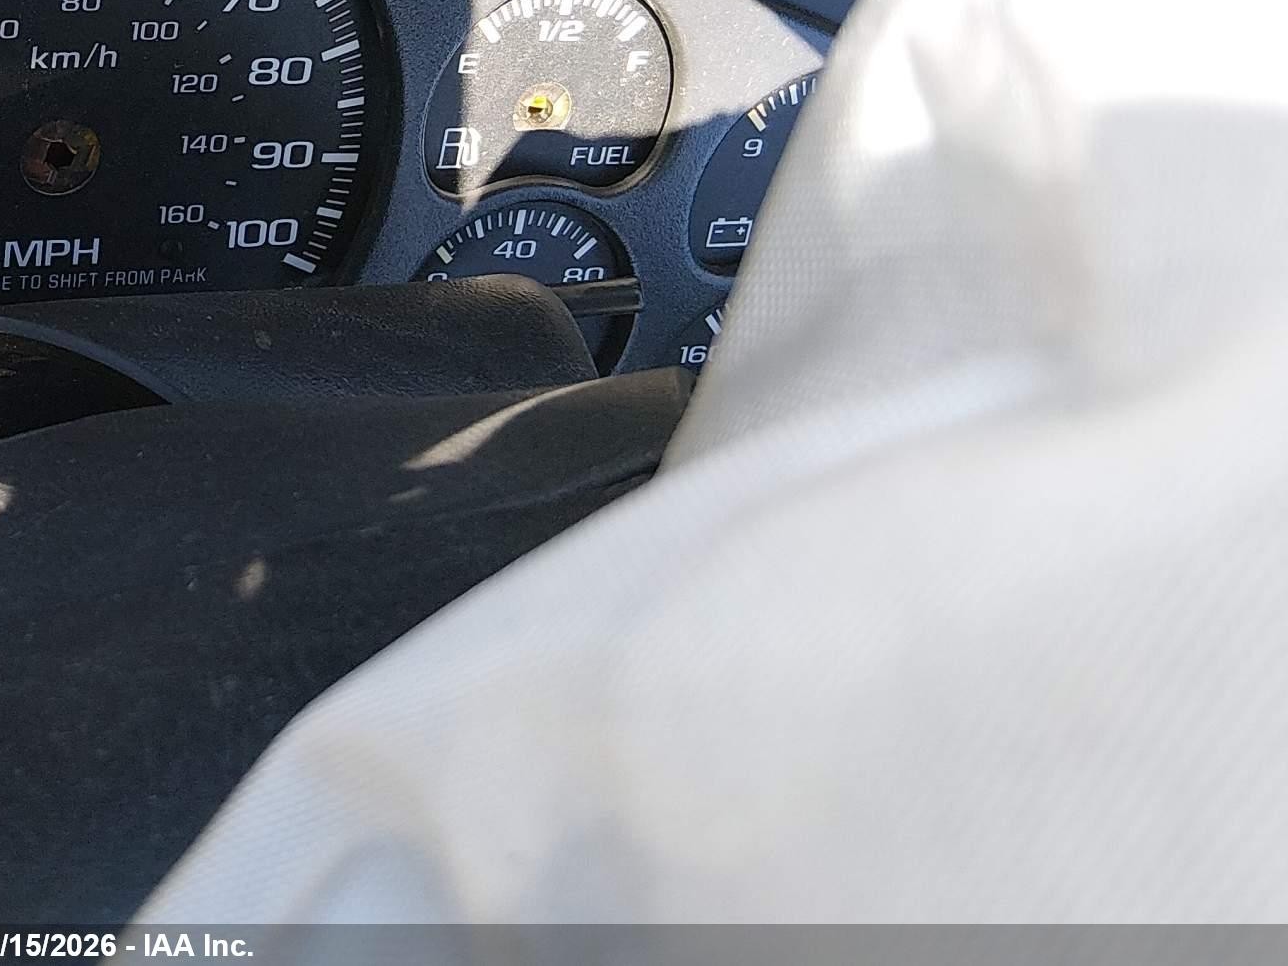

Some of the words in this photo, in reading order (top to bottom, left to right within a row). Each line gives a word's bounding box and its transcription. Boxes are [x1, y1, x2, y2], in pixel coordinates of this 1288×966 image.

[131, 21, 179, 41] 100
[537, 19, 586, 43] 1/2
[30, 44, 118, 70] km/h
[458, 52, 480, 75] E
[626, 51, 652, 71] F
[248, 57, 312, 86] 80
[171, 73, 218, 94] 120
[181, 134, 228, 154] 140
[742, 138, 764, 158] 9
[251, 141, 314, 170] 90
[570, 146, 636, 167] FUEL
[159, 205, 205, 225] 160
[226, 219, 299, 250] 100
[3, 238, 101, 268] MPH
[493, 240, 537, 259] 40
[20, 274, 42, 291] TO
[48, 272, 98, 289] SHIFT
[105, 270, 154, 286] FROM
[679, 344, 712, 365] 16
